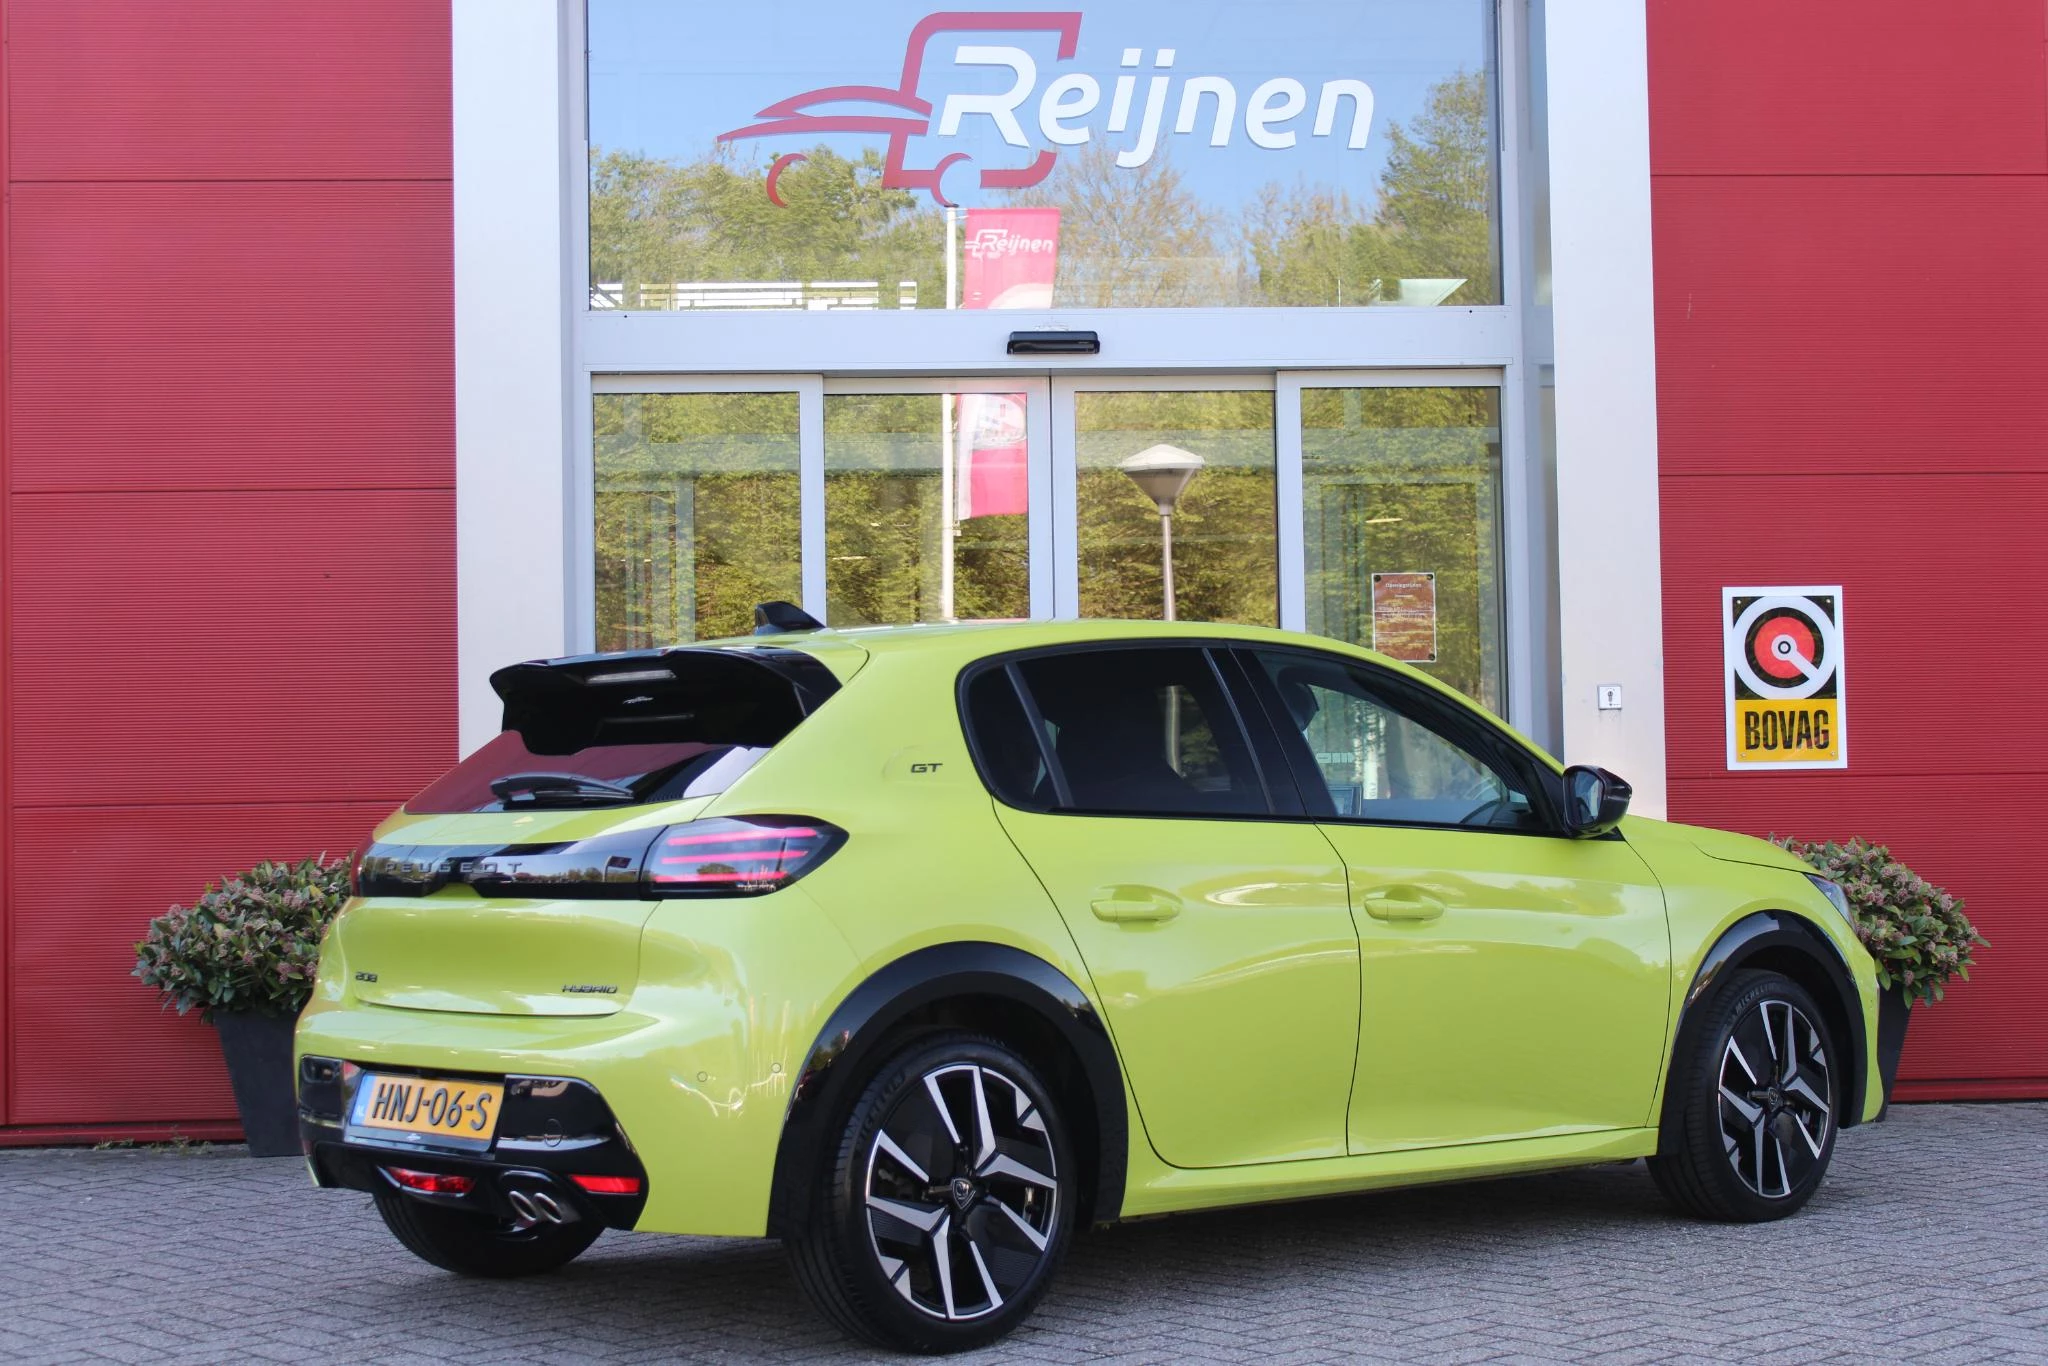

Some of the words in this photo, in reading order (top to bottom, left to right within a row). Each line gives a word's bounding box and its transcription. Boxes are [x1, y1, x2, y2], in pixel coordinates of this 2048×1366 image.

[937, 45, 1374, 168] Reijnen
[980, 234, 1054, 256] Reijnen
[1744, 709, 1830, 751] BOVAG
[911, 763, 943, 773] GT
[385, 861, 523, 875] PEUGEOT
[355, 971, 378, 983] 208
[562, 984, 618, 994] HYBRID
[371, 1082, 492, 1131] HNJ-06-S
